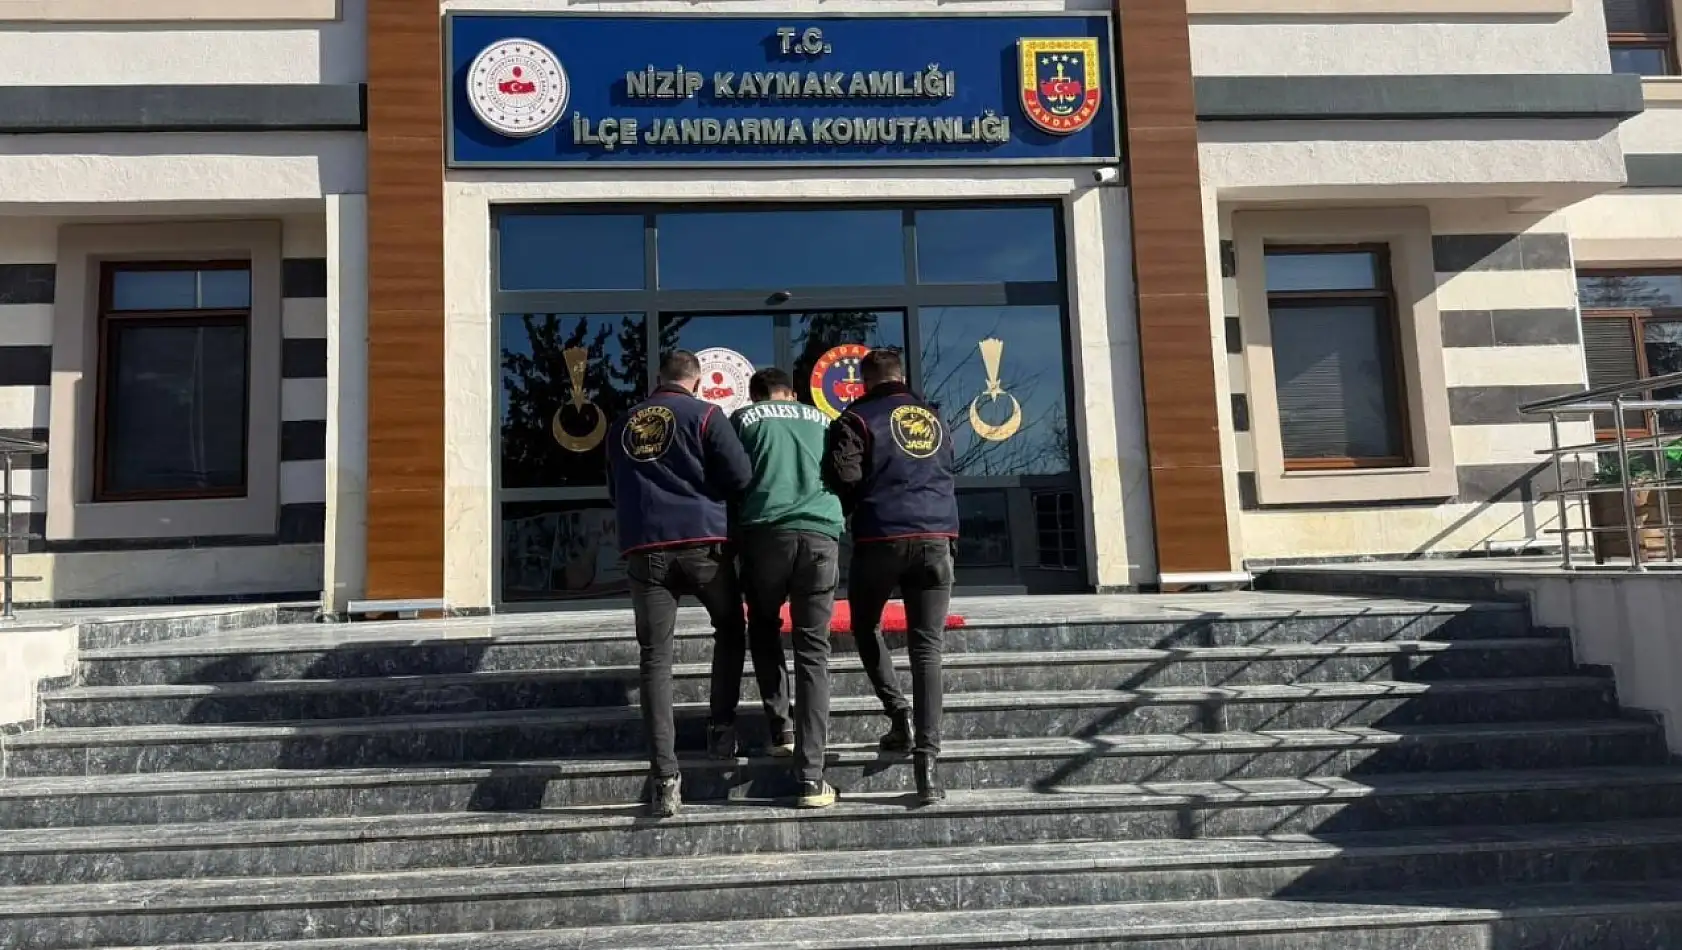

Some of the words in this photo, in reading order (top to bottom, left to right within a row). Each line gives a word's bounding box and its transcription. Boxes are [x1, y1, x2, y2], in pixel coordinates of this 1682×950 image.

[776, 27, 832, 54] T.C.
[626, 64, 704, 98] NİZİP
[714, 62, 955, 98] KAYMAKAMLIĞI
[1027, 98, 1097, 127] JANDARMA
[573, 110, 638, 150] İLÇE
[644, 117, 808, 145] JANDARMA
[812, 108, 1011, 144] KOMUTANLIĞI
[814, 346, 871, 379] JANDA
[741, 404, 799, 428] RECKLESS
